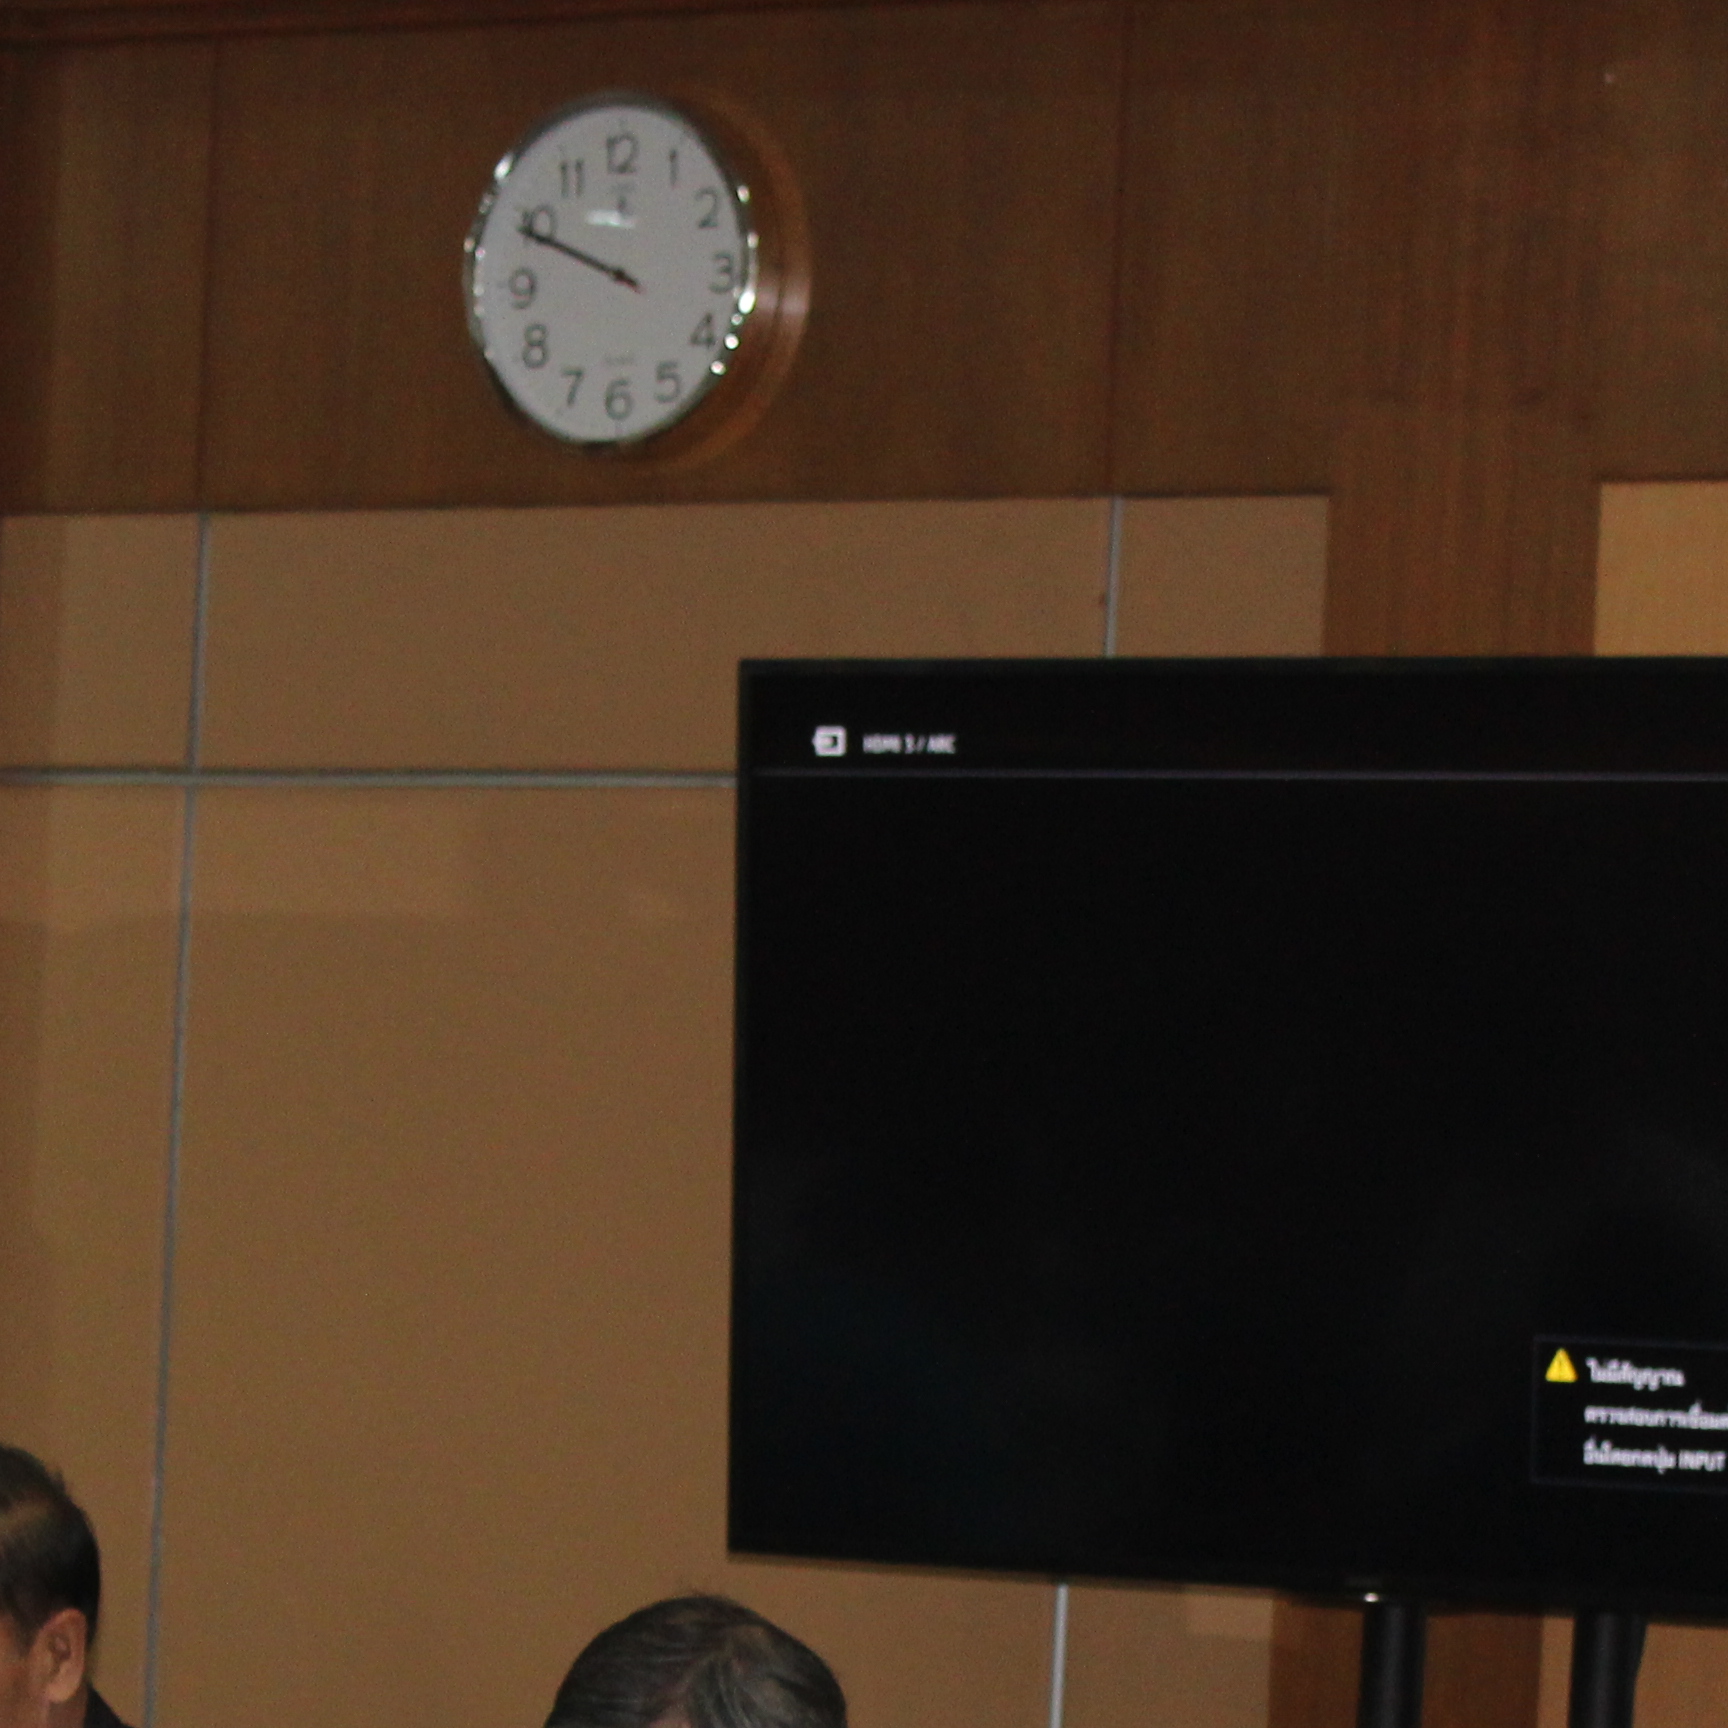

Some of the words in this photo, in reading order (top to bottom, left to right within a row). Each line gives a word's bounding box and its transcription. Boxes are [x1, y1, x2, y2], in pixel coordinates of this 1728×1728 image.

[606, 132, 640, 175] 12
[667, 148, 679, 186] 1
[559, 159, 586, 197] 11
[694, 188, 719, 229] 2
[508, 267, 536, 309] 9
[708, 251, 735, 294] 3
[522, 323, 549, 369] 8
[690, 313, 716, 349] 4
[561, 366, 584, 406] 7
[605, 378, 633, 420] 6
[655, 360, 682, 403] 5
